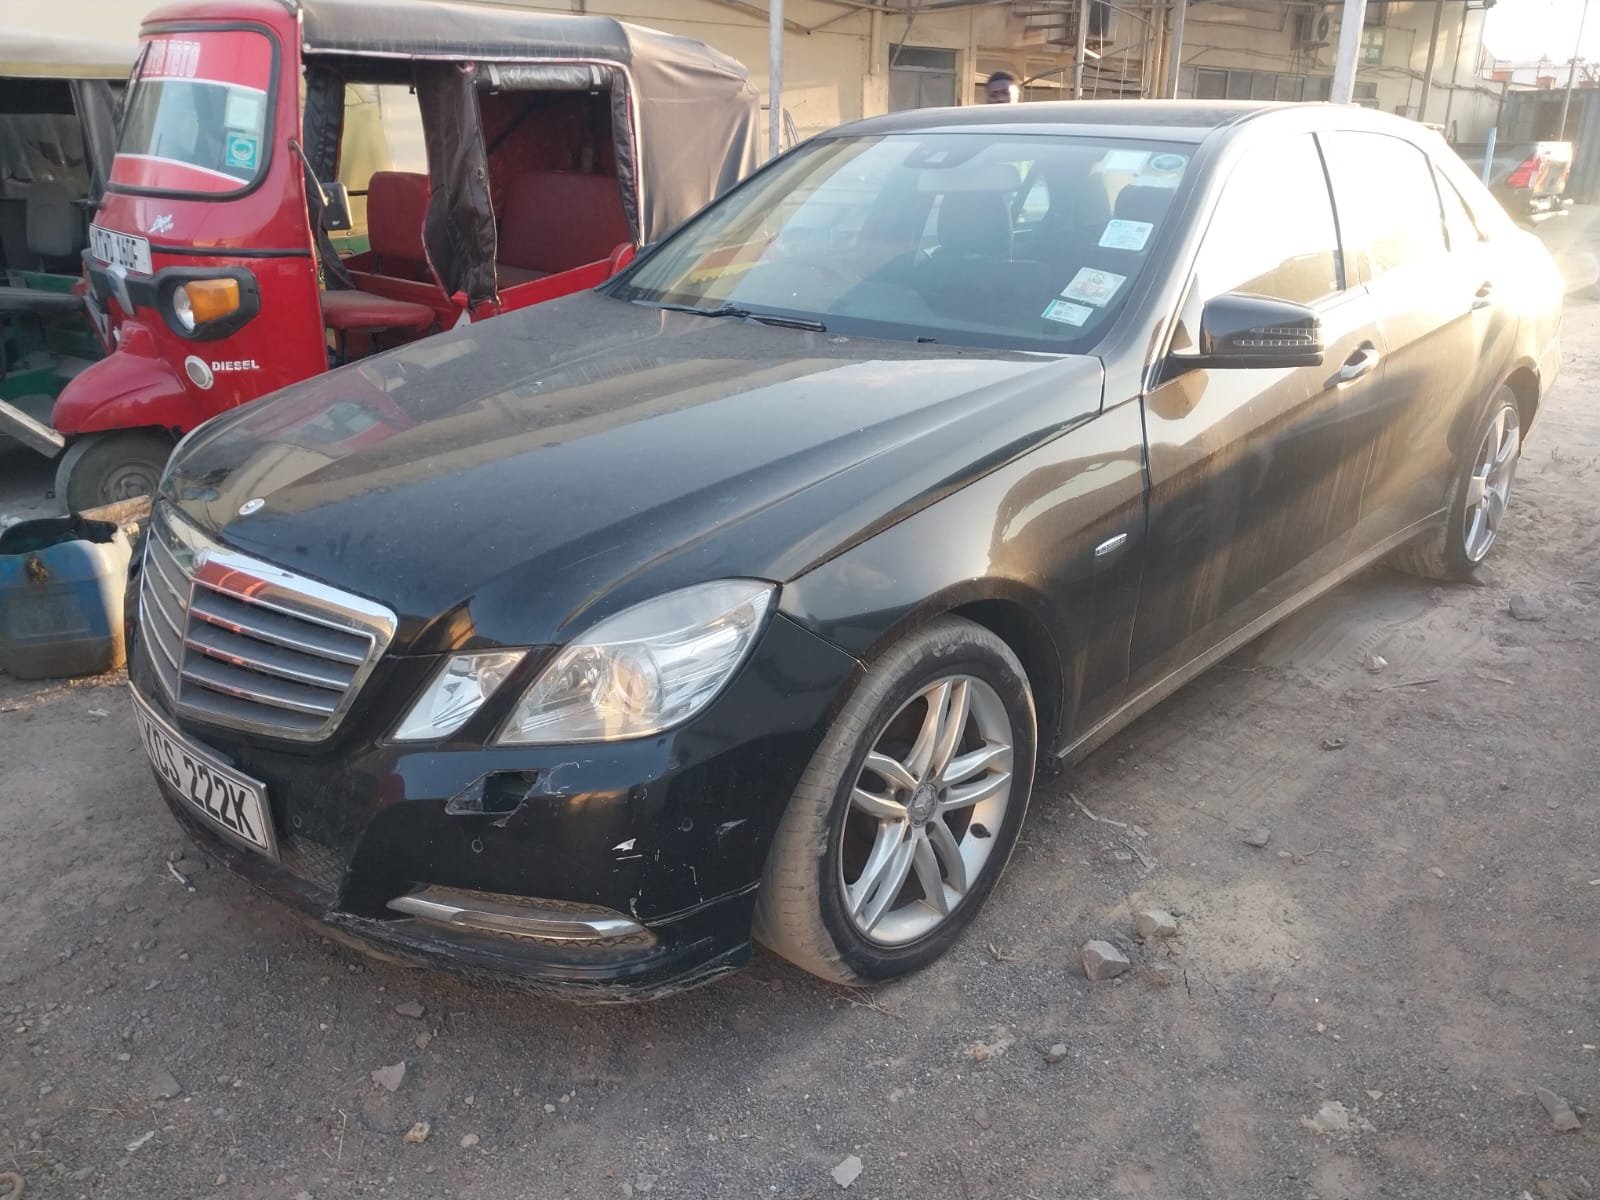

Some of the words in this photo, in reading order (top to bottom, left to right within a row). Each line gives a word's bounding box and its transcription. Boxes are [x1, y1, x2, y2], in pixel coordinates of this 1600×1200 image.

[211, 359, 260, 371] DIESEL
[141, 715, 181, 788] KCS
[183, 754, 257, 841] 222K
